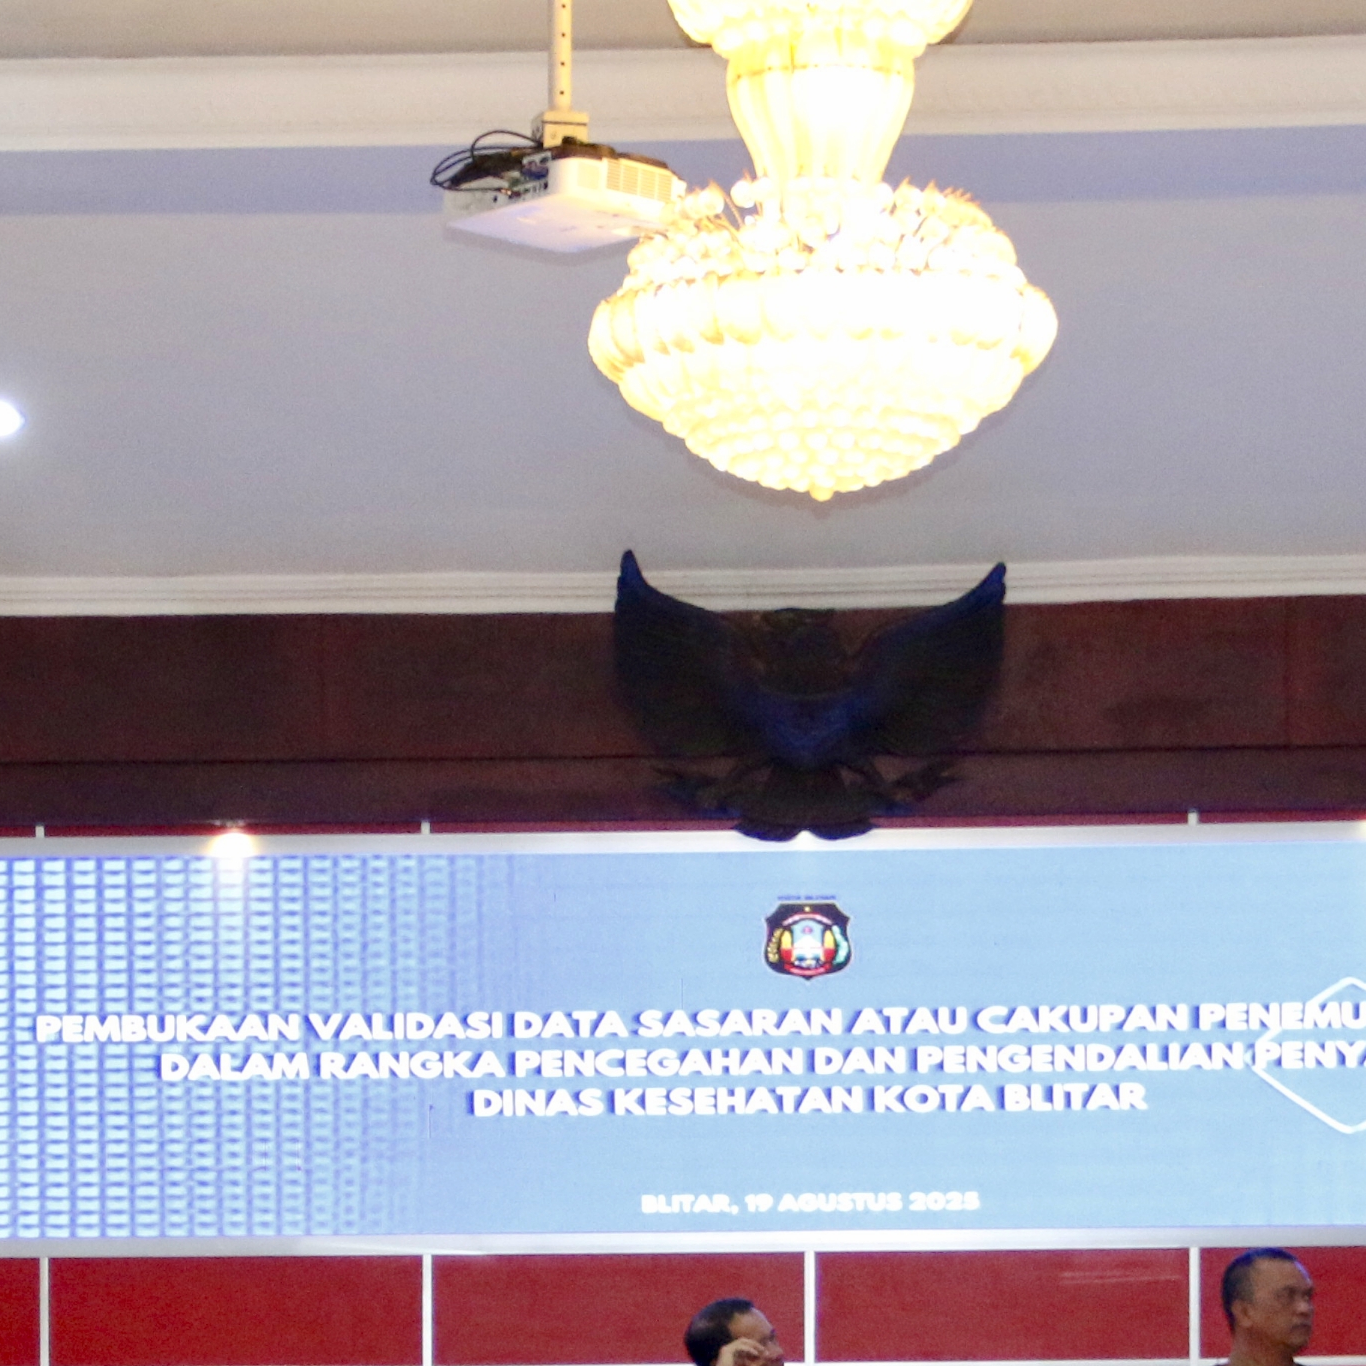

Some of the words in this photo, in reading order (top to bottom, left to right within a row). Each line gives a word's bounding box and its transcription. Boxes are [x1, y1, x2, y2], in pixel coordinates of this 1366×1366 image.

[35, 1013, 301, 1044] PEMBUKAAN
[308, 1011, 504, 1042] VALIDASI
[514, 1010, 629, 1039] DATA
[638, 1008, 843, 1038] SASARAN
[851, 1006, 968, 1035] ATAU
[977, 1003, 1190, 1034] CAKUPAN
[161, 1051, 311, 1082] DALAM
[320, 1050, 506, 1080] RANGKA
[515, 1047, 807, 1078] PENCEGAHAN
[815, 1046, 908, 1075] DAN
[918, 1042, 1243, 1074] PENGENDALIAN
[473, 1088, 605, 1118] DINAS
[614, 1085, 864, 1117] KESEHATAN
[874, 1083, 997, 1114] KOTA
[1005, 1081, 1148, 1112] BLITAR
[641, 1193, 739, 1216] BLITAR,
[746, 1193, 773, 1212] 19
[777, 1192, 903, 1213] AGUSTUS
[909, 1191, 980, 1211] 2025
